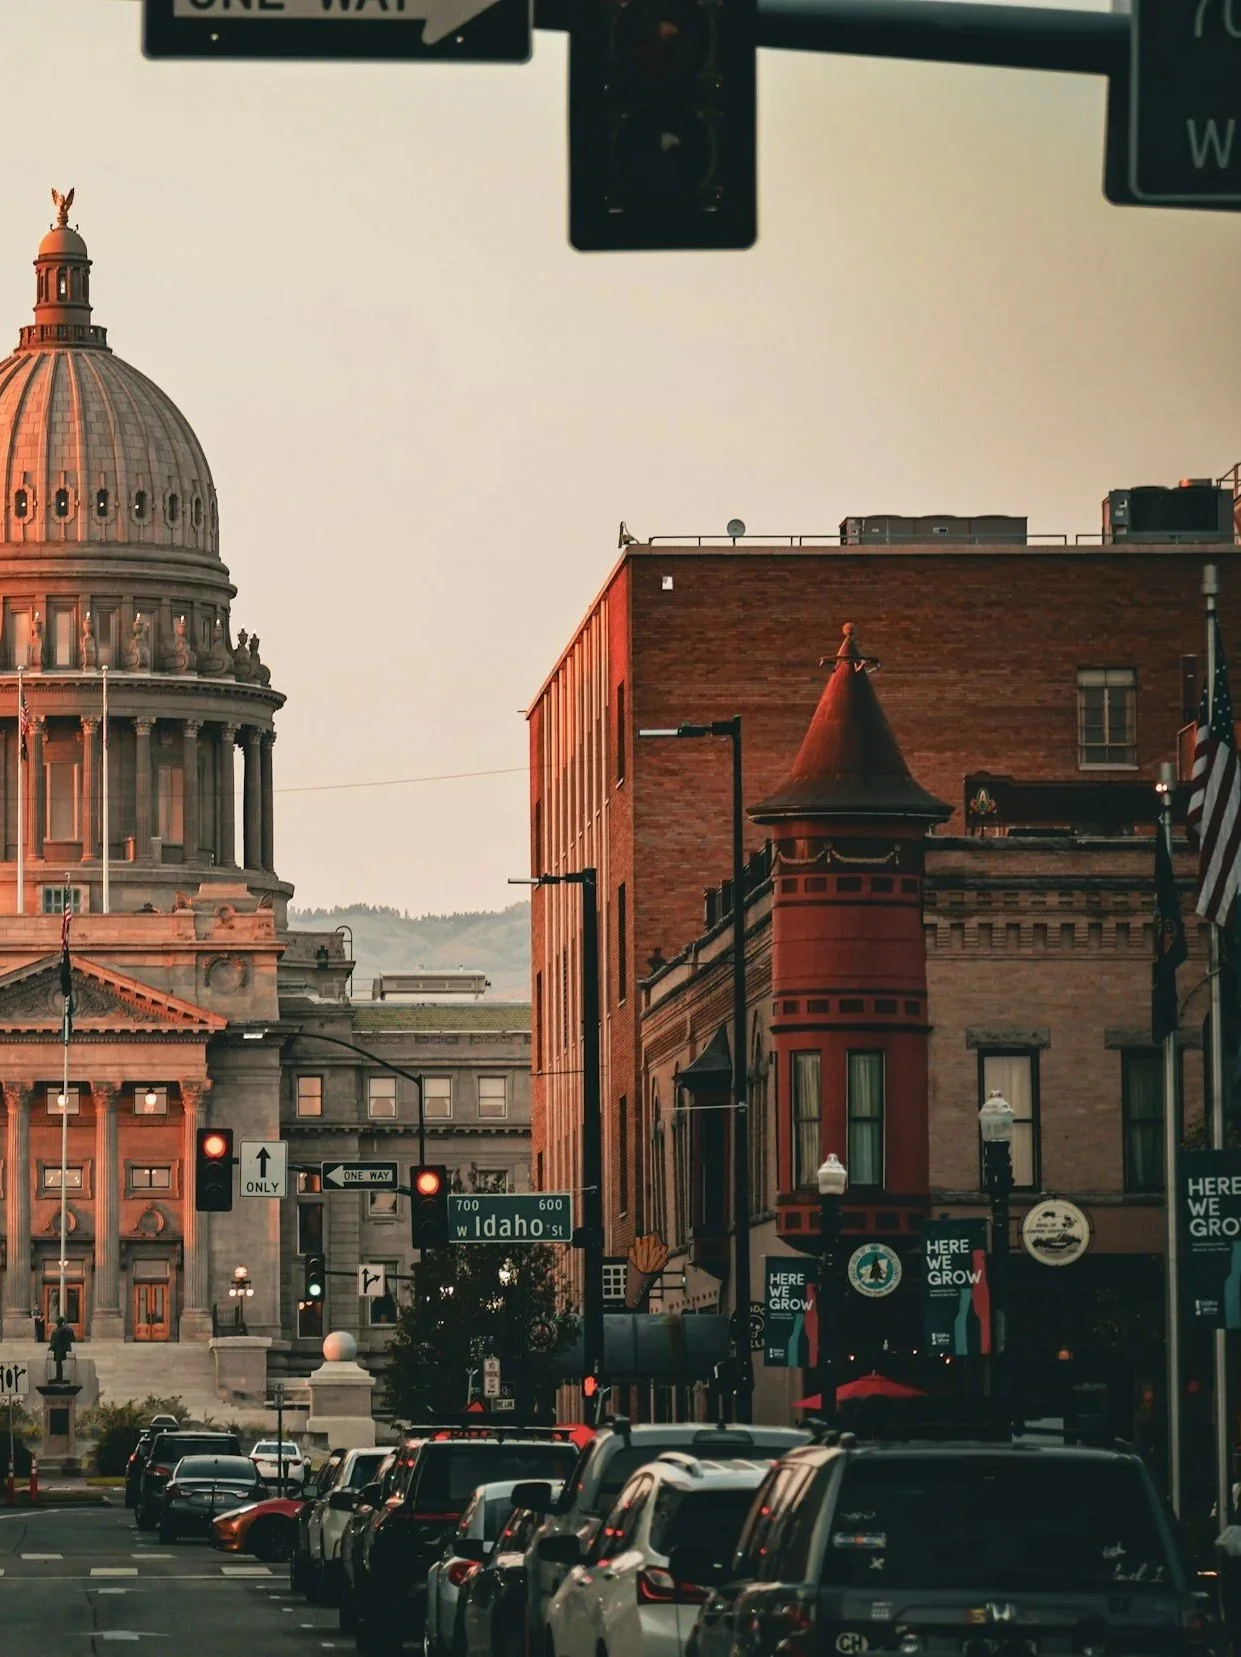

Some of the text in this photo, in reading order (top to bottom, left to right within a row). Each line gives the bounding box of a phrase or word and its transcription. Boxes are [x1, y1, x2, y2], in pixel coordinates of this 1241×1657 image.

[1186, 117, 1236, 169] W
[343, 1170, 390, 1180] ONE WAY
[246, 1181, 280, 1193] ONLY
[1187, 1176, 1241, 1196] HERE
[456, 1199, 563, 1211] 700 600
[1187, 1197, 1221, 1217] WE
[456, 1213, 563, 1237] W Idaho St
[1189, 1217, 1241, 1237] GRO
[926, 1239, 970, 1254] HERE
[926, 1255, 952, 1270] WE
[770, 1272, 805, 1286] HERE
[927, 1270, 982, 1285] GROW
[769, 1286, 790, 1298] WE
[769, 1298, 813, 1311] GROW
[840, 1635, 862, 1651] CH
